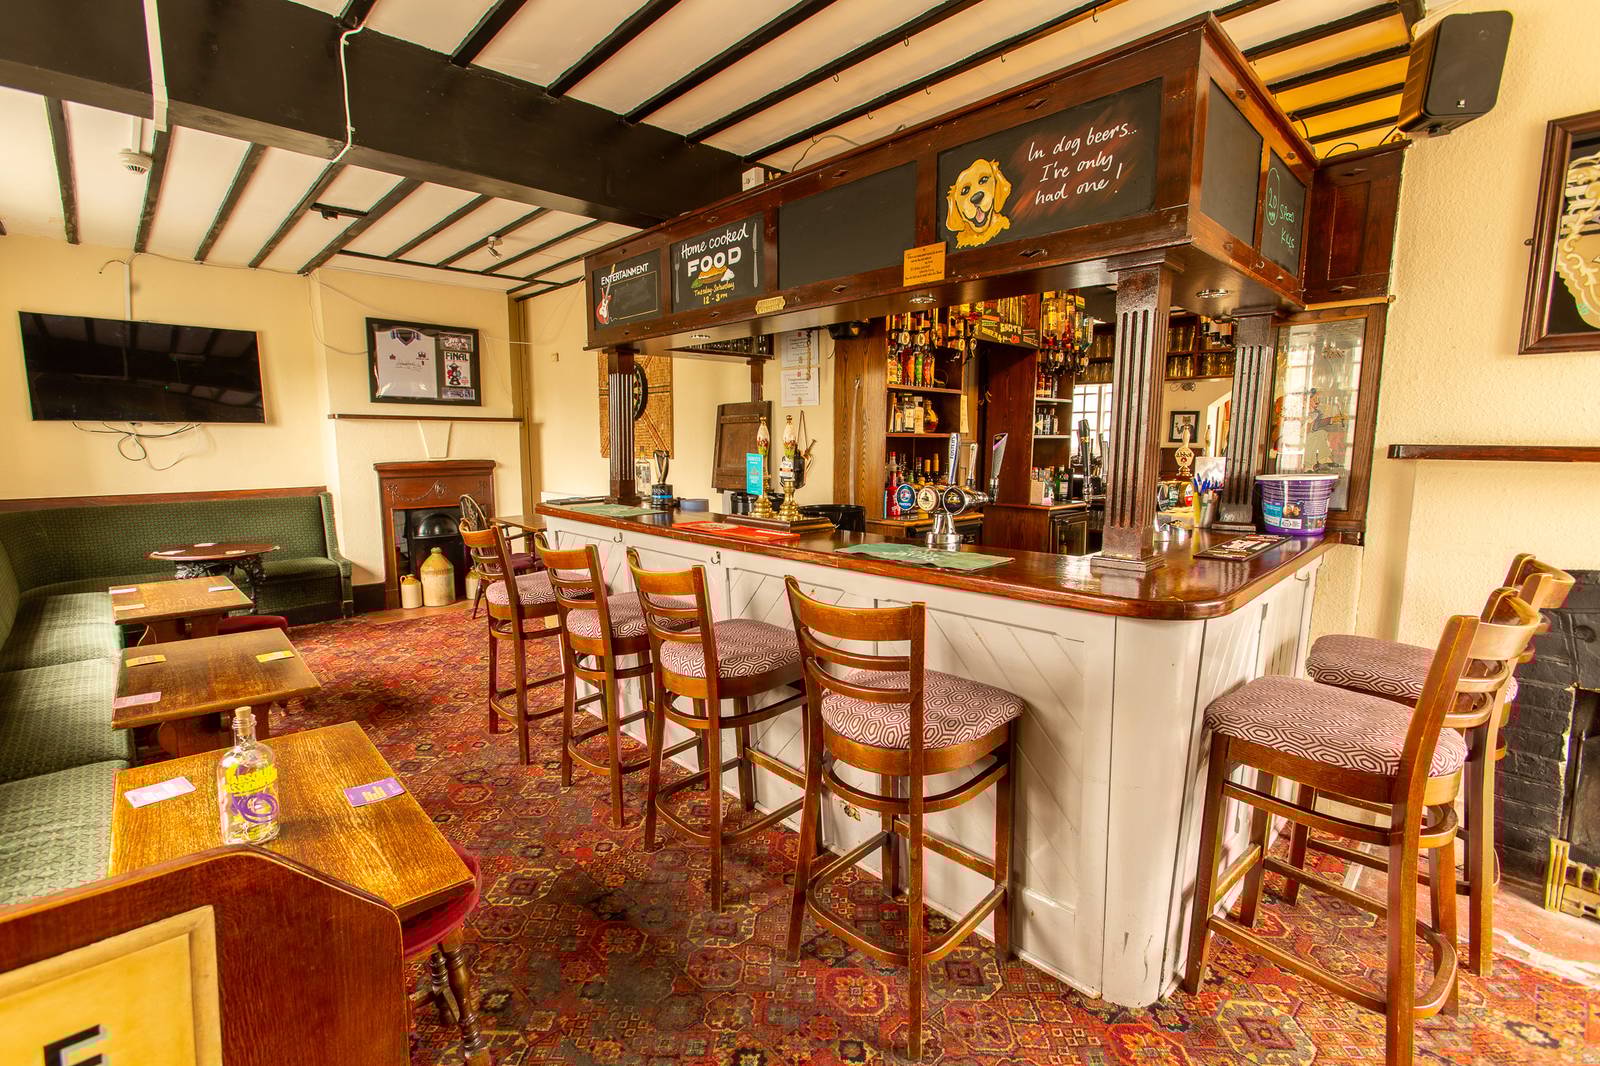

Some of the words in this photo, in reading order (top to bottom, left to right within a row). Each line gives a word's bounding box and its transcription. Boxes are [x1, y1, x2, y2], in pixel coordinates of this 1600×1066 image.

[1028, 141, 1046, 162] In
[1052, 135, 1081, 157] dog
[1039, 160, 1071, 183] I've
[1076, 151, 1113, 172] only
[1035, 183, 1069, 206] had
[1076, 178, 1110, 195] one
[681, 241, 708, 260] Home
[708, 222, 749, 250] cooked
[601, 262, 649, 286] ENTERTAINMENT
[687, 246, 742, 277] FOOD
[703, 296, 710, 305] 12
[445, 352, 469, 362] FINAL
